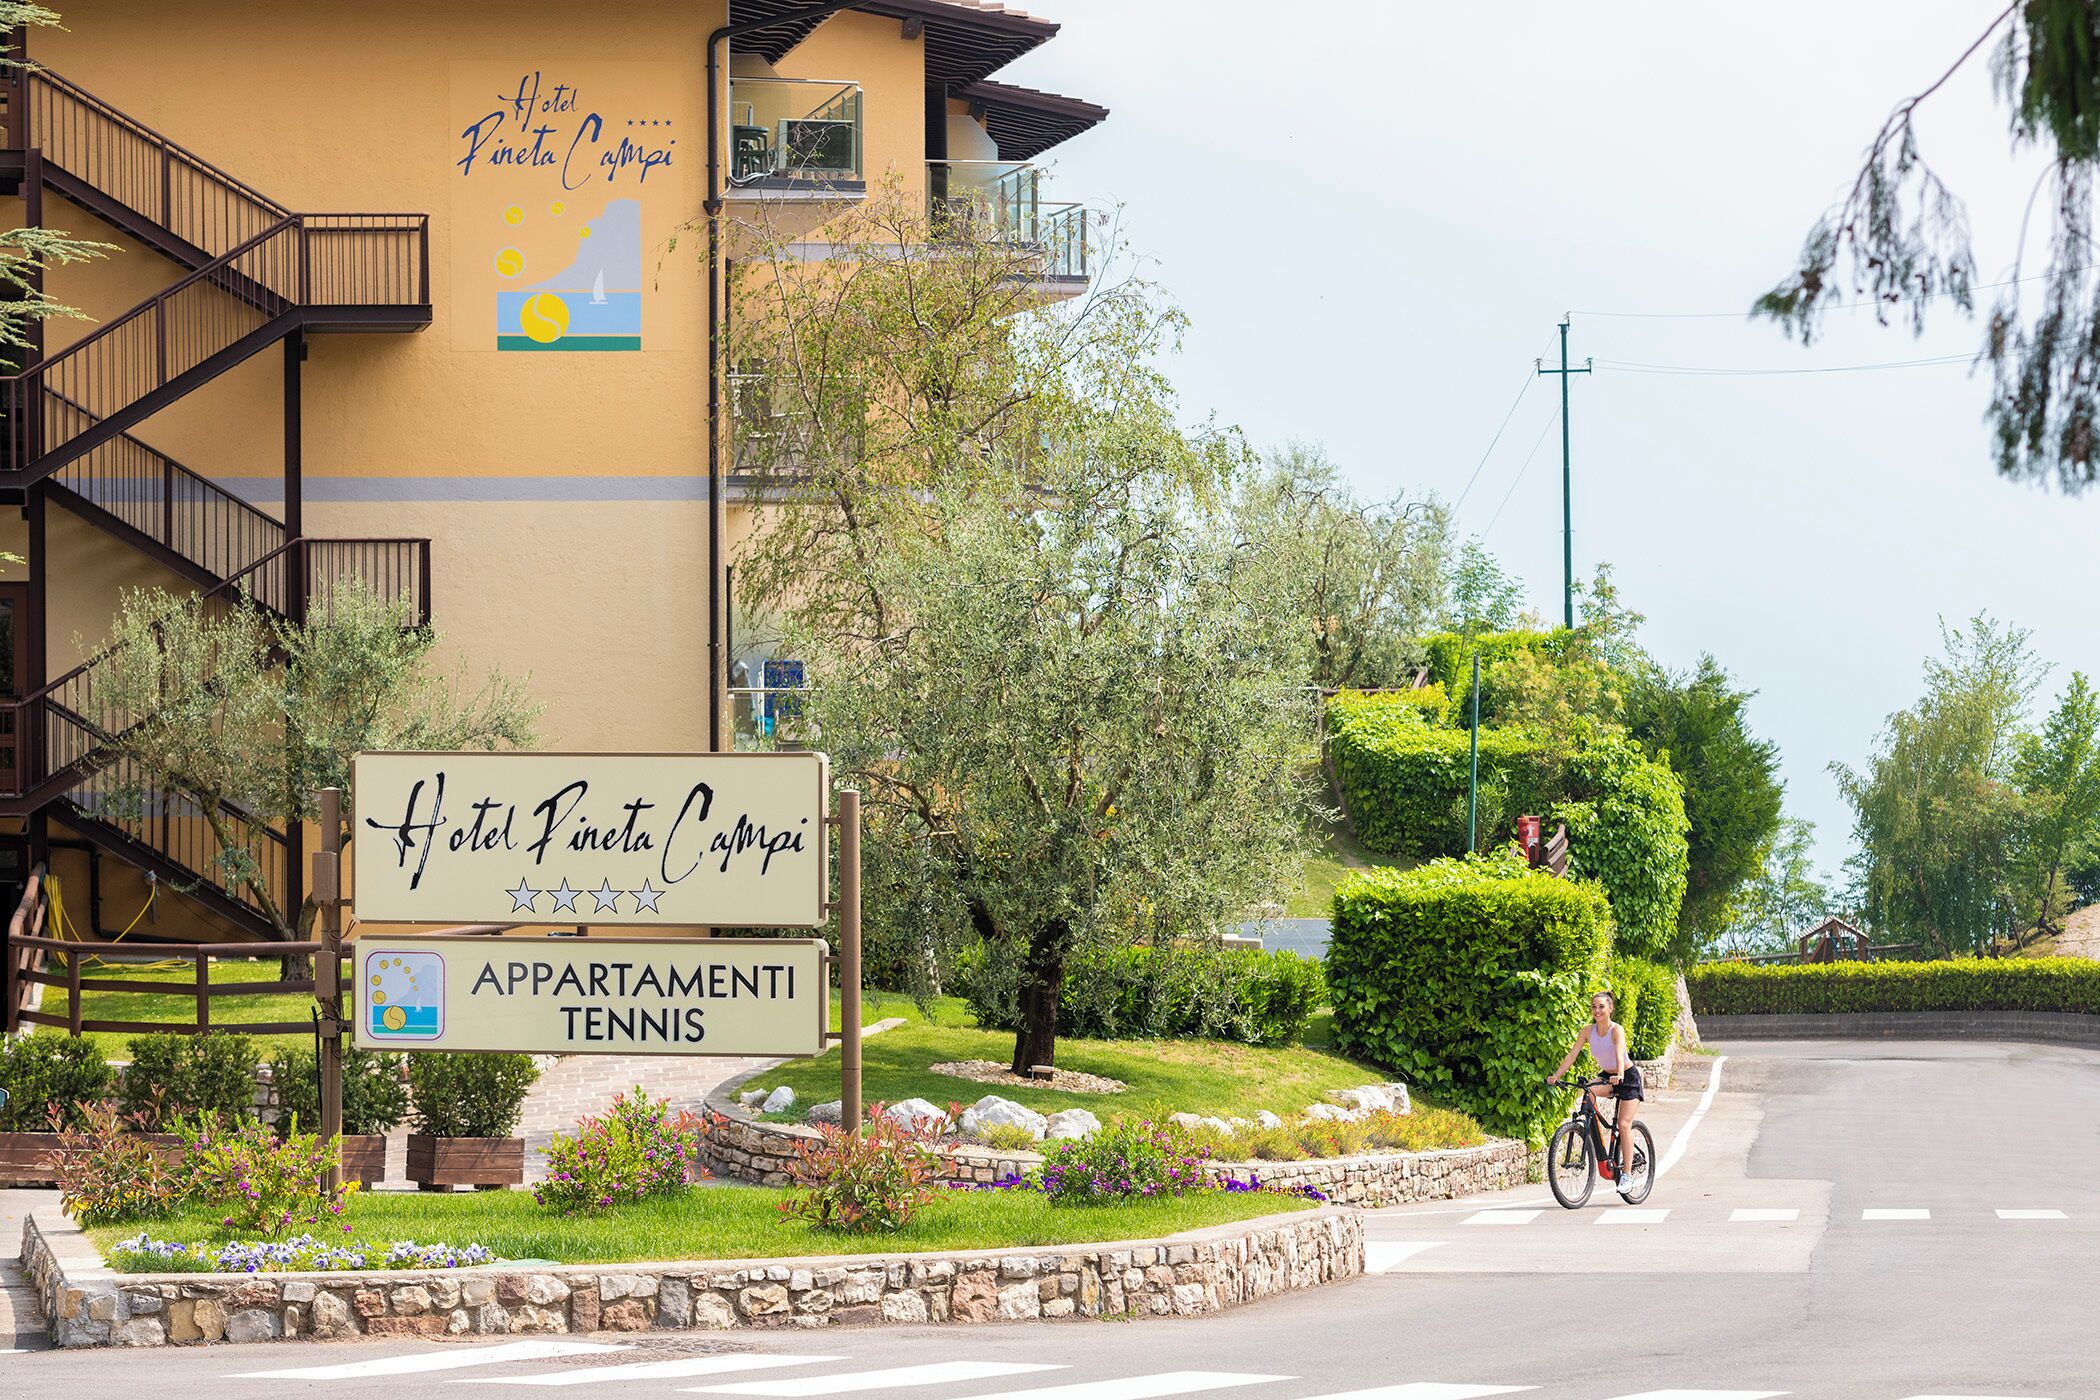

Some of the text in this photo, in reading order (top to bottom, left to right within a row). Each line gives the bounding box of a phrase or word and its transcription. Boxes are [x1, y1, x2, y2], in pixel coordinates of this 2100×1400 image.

[497, 71, 579, 133] Hotel
[456, 110, 677, 191] Pineta Campi
[366, 771, 809, 890] Hotel Pineta Campi
[470, 961, 796, 1000] APPARTAMENTI
[559, 1006, 706, 1043] TENNIS
